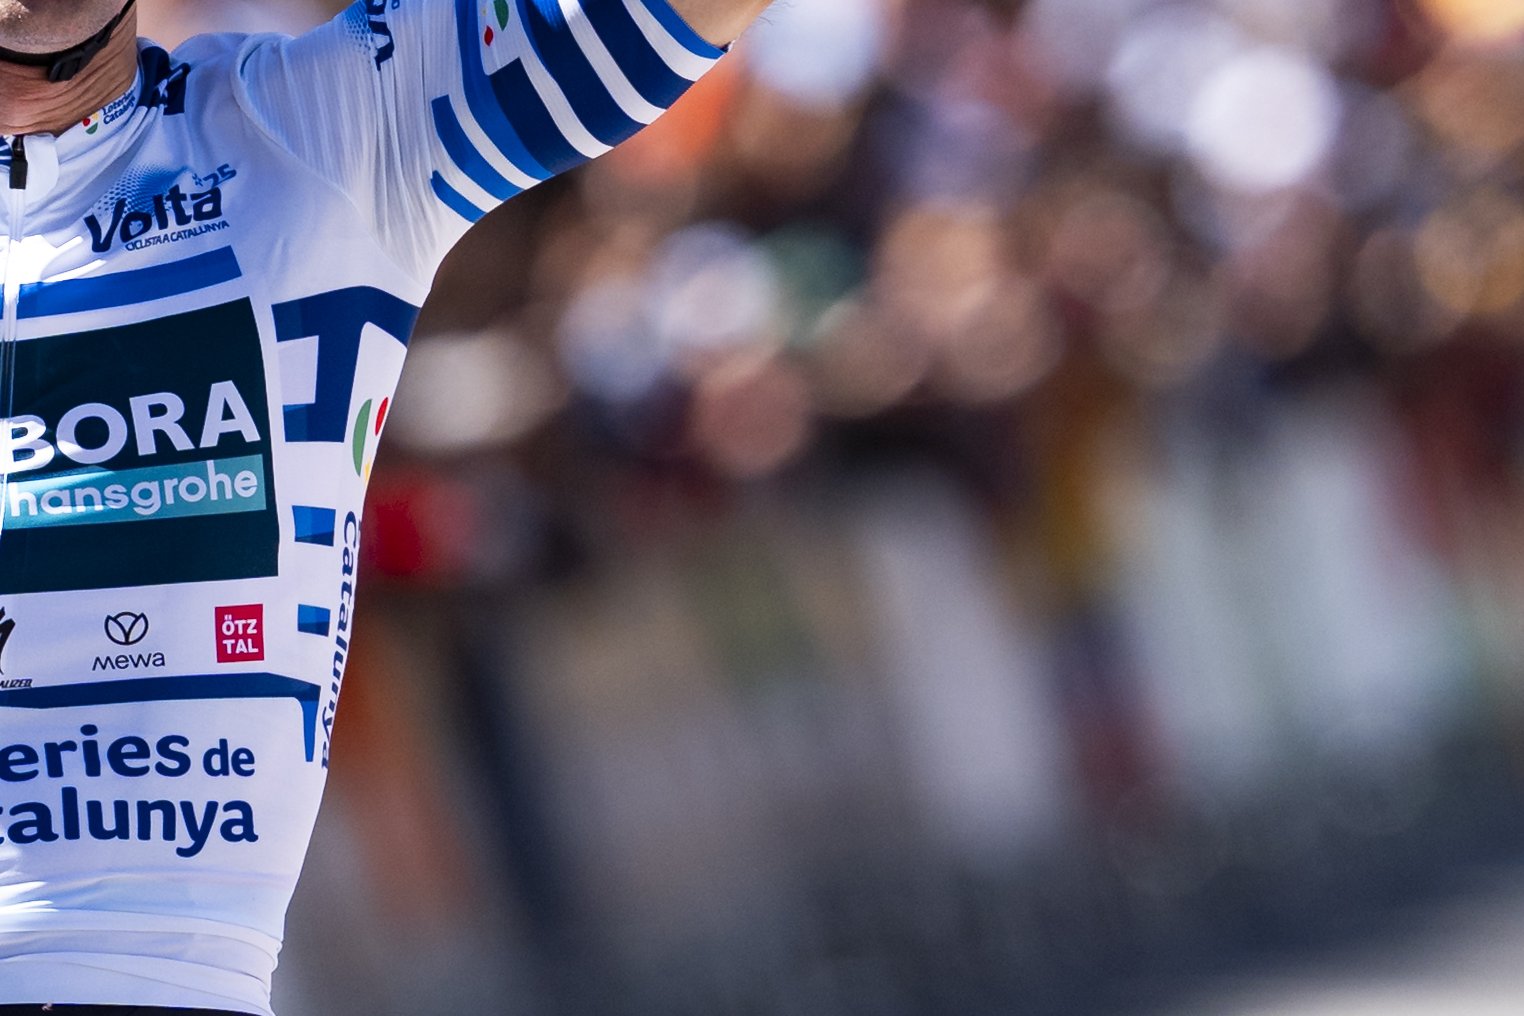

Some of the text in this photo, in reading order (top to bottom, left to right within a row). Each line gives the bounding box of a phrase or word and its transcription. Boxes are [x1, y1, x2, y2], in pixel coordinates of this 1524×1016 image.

[83, 184, 222, 253] Volta
[7, 460, 258, 517] hansgrohe
[222, 614, 258, 635] ÖTZ
[222, 638, 259, 654] TAL
[202, 739, 256, 777] de
